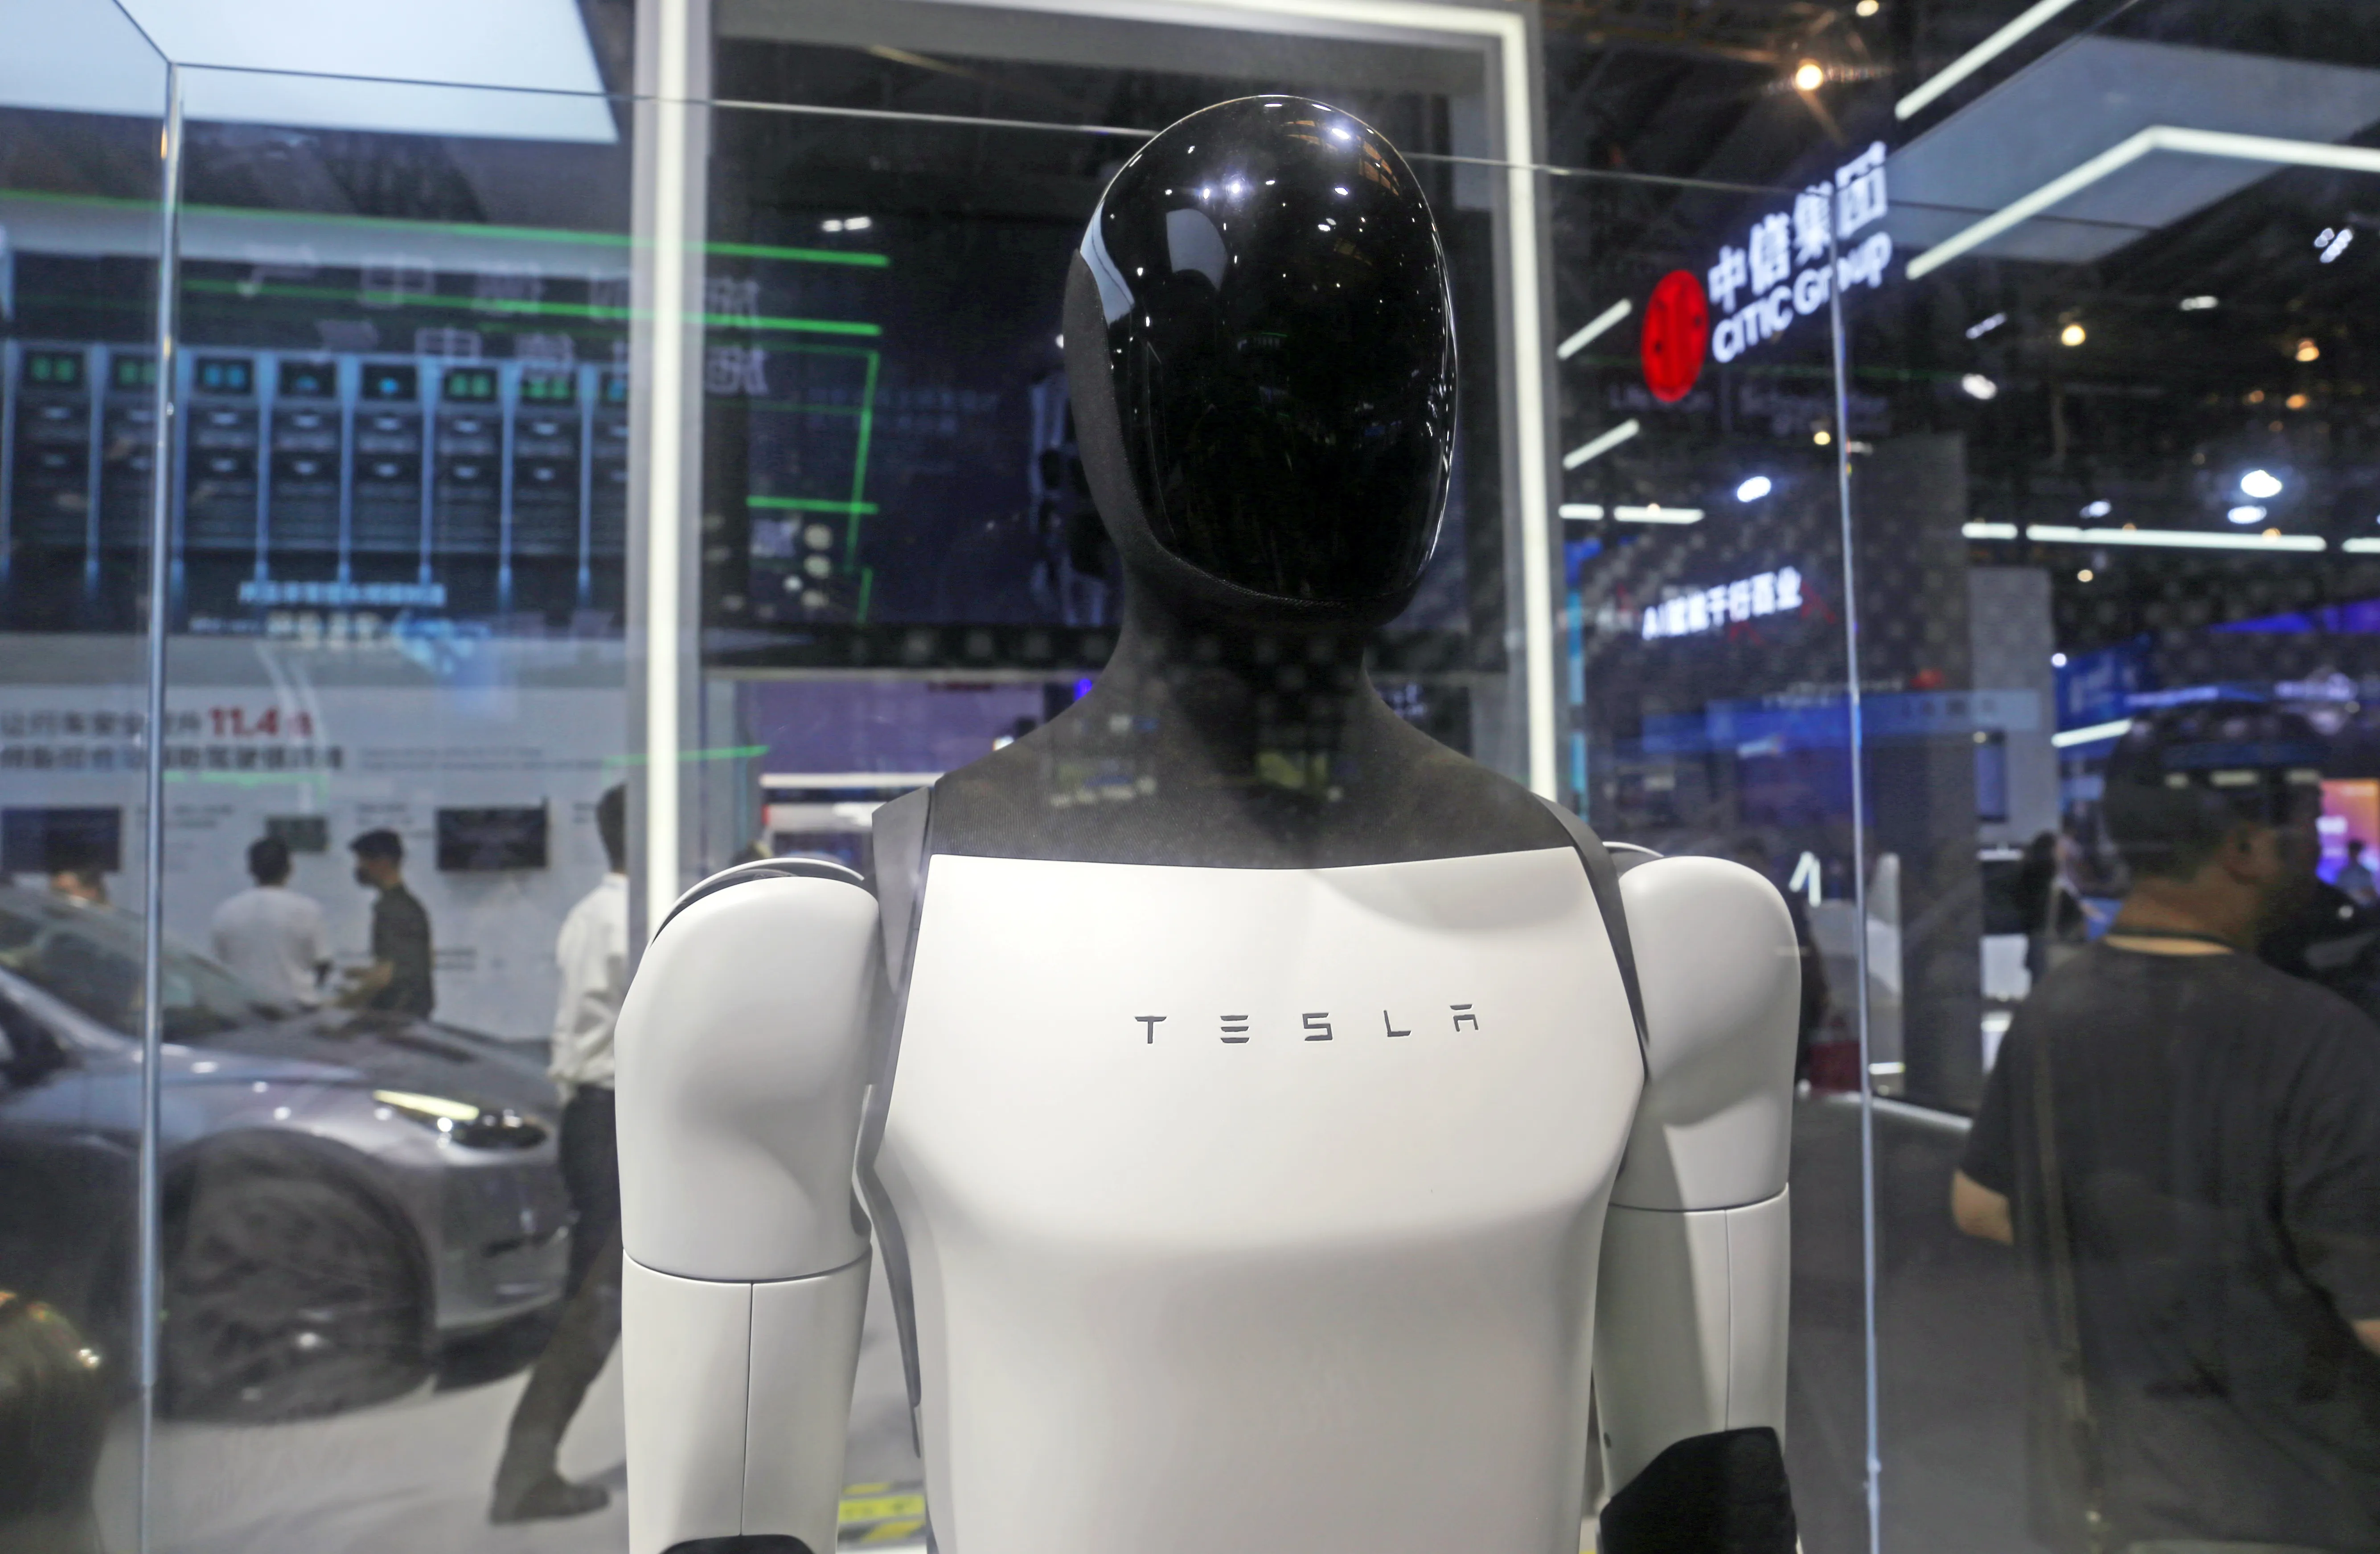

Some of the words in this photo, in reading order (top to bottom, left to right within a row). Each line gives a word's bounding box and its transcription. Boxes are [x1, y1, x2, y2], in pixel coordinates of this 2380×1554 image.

[1708, 141, 1888, 313] 中信集团
[1712, 285, 1793, 363] CITIC
[1134, 1003, 1479, 1044] TESLA
